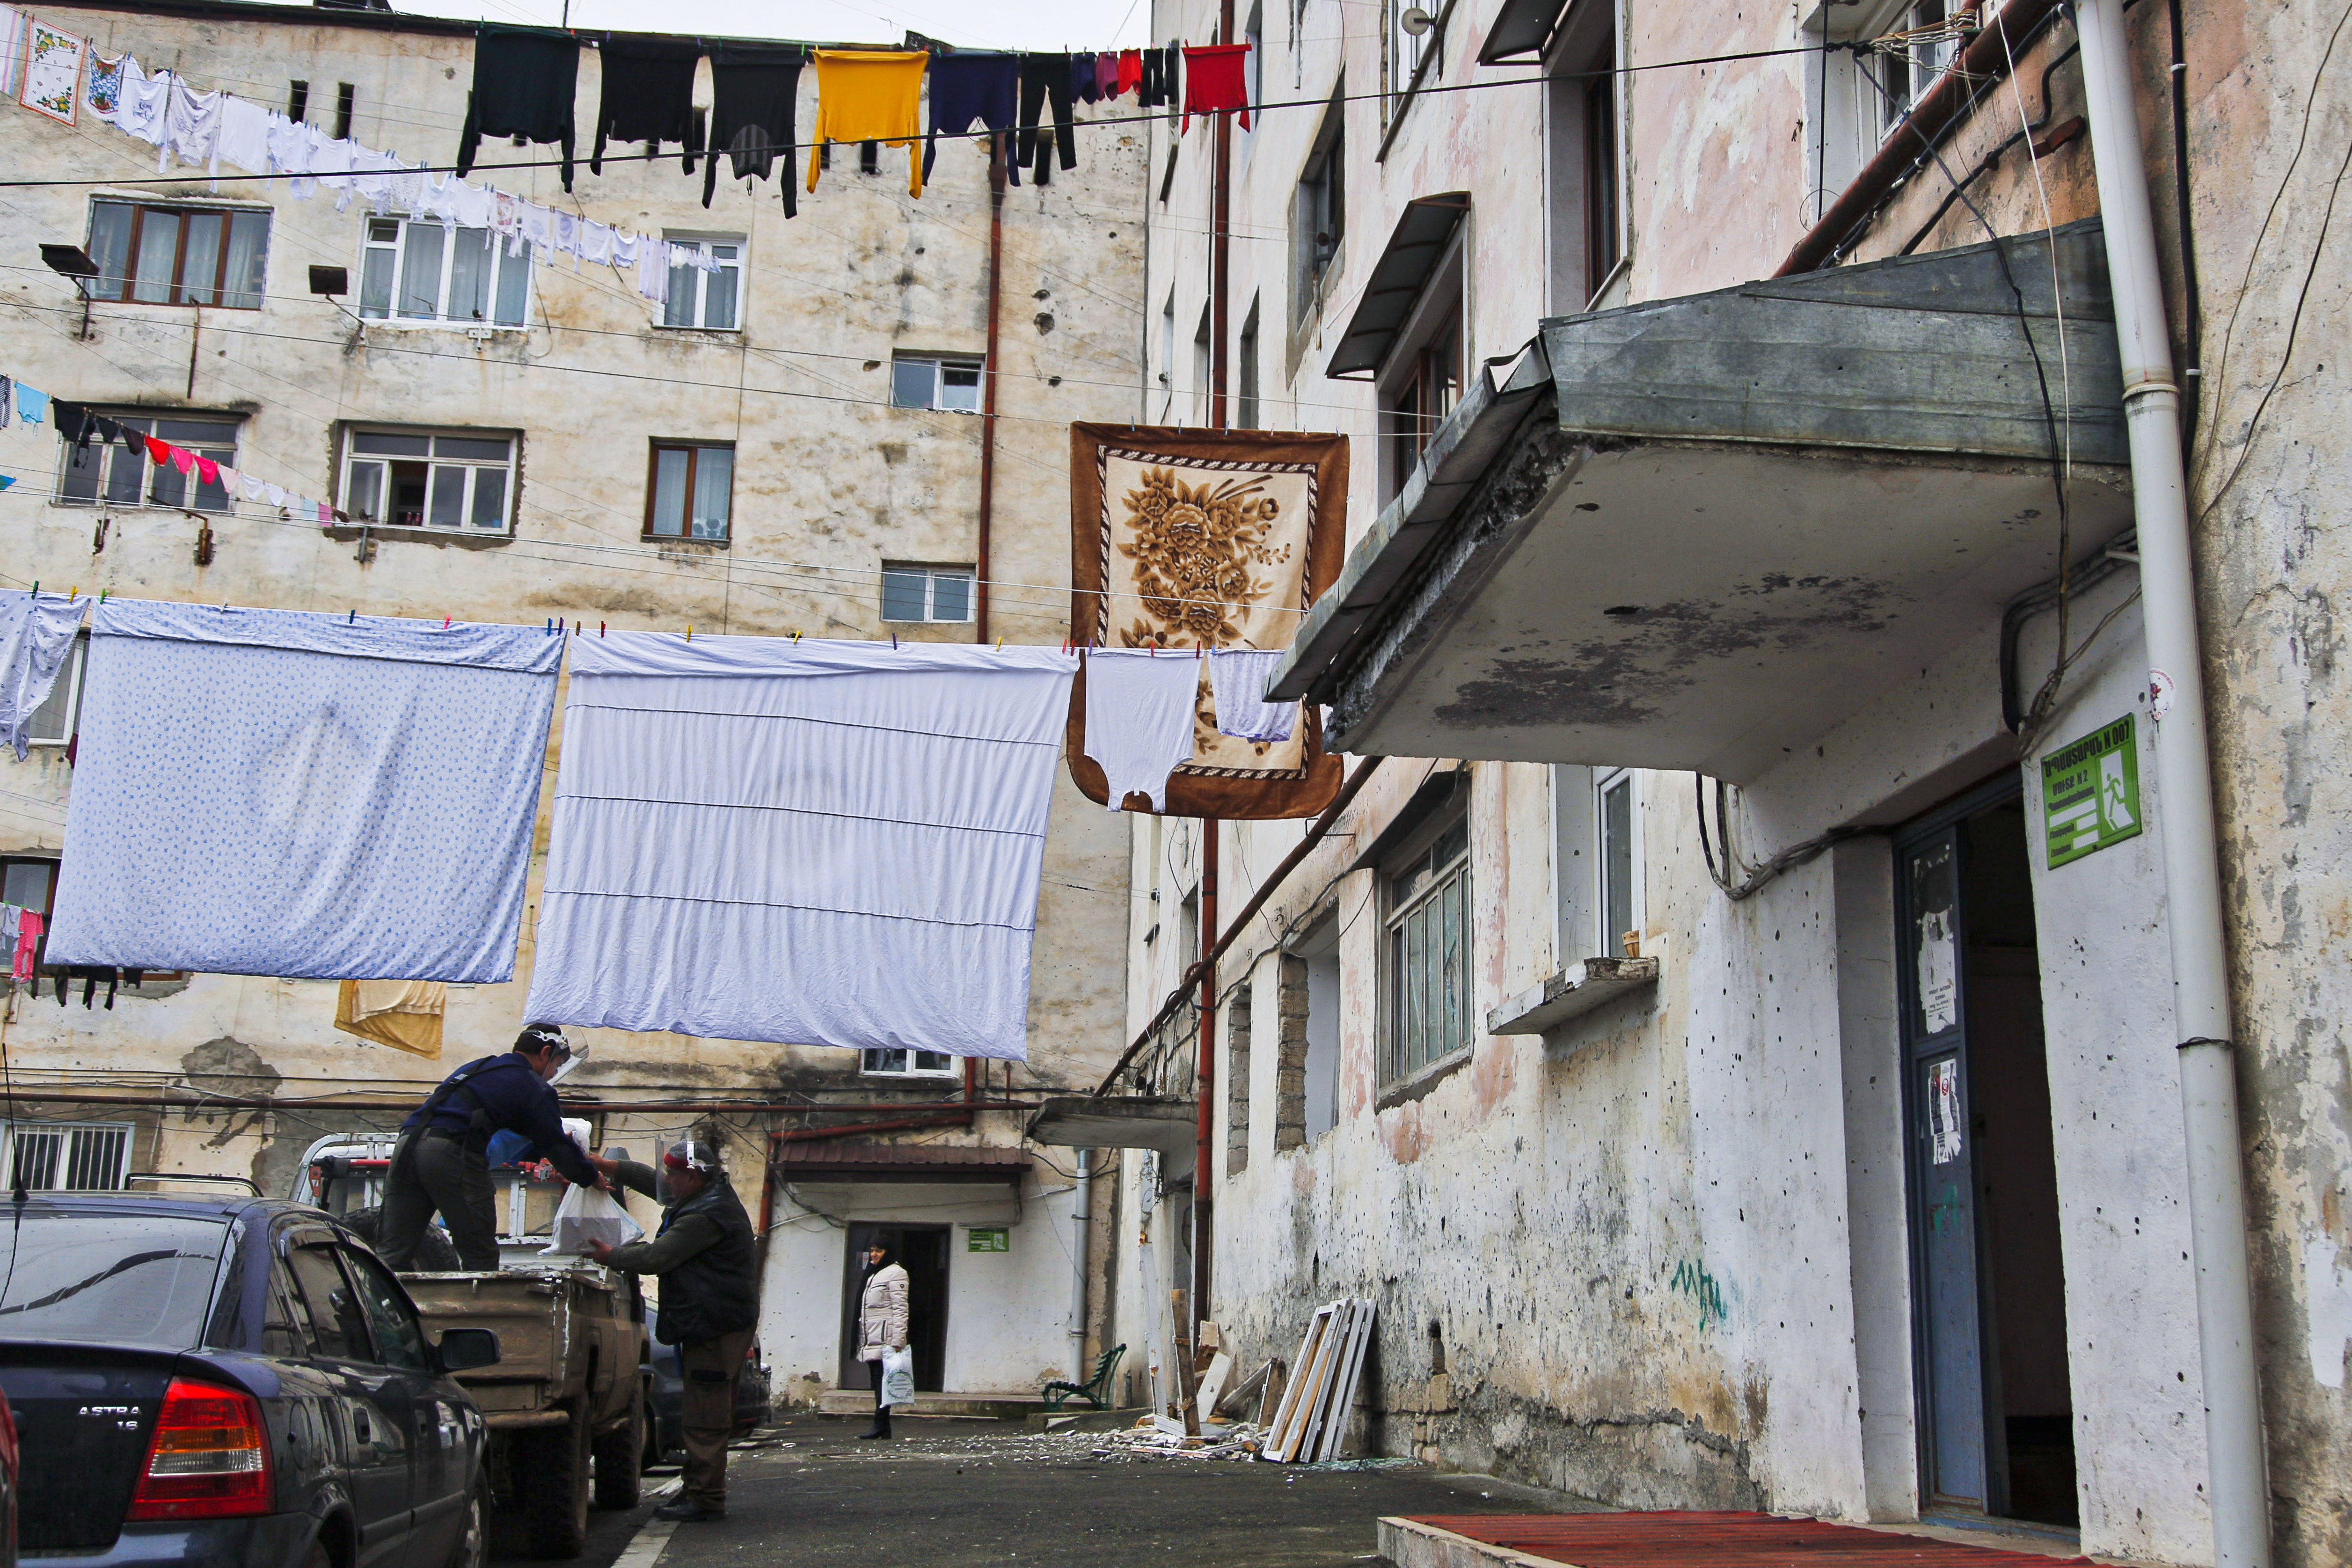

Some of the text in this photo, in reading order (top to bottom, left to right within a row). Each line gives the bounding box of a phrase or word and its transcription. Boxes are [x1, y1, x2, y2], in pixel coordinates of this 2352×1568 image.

[2104, 730, 2111, 750] N
[2077, 771, 2082, 785] N
[2083, 769, 2088, 782] 2
[78, 1407, 142, 1416] ASTRA
